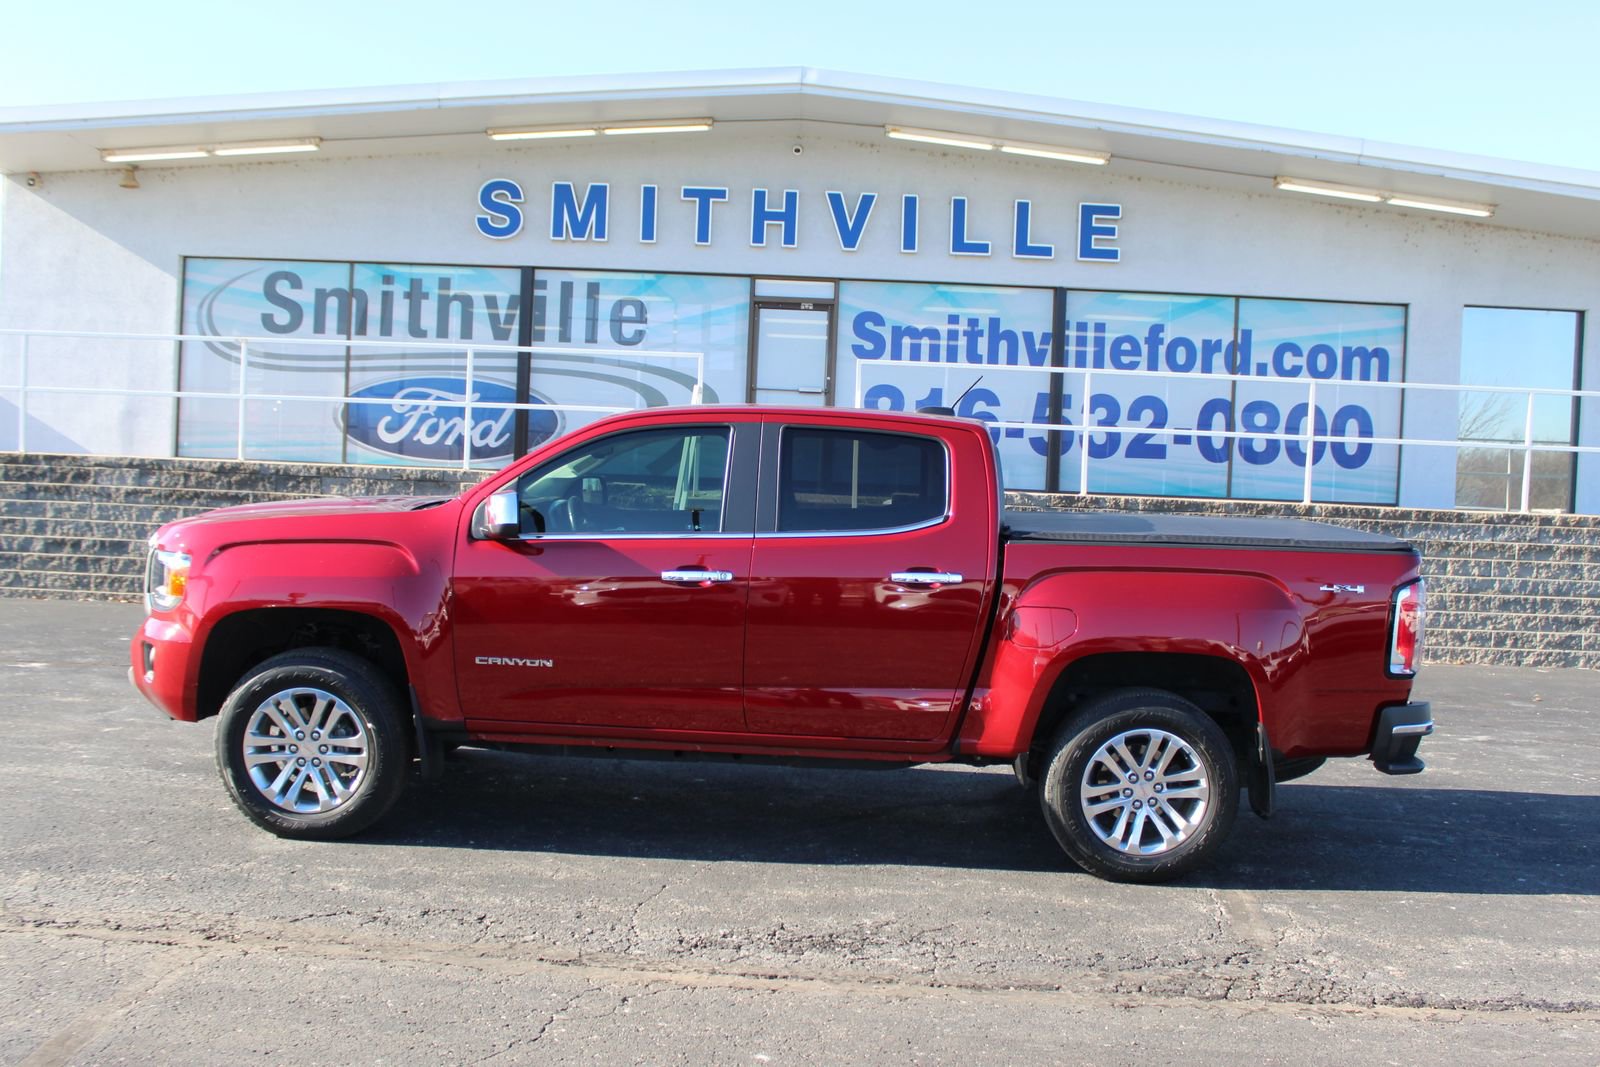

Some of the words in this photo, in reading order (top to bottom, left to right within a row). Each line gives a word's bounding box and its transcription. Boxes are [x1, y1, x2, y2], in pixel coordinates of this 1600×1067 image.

[475, 179, 1122, 263] SMITHVILLE
[260, 270, 648, 346] Smithville
[377, 387, 515, 448] Ford
[475, 656, 553, 668] CANYON
